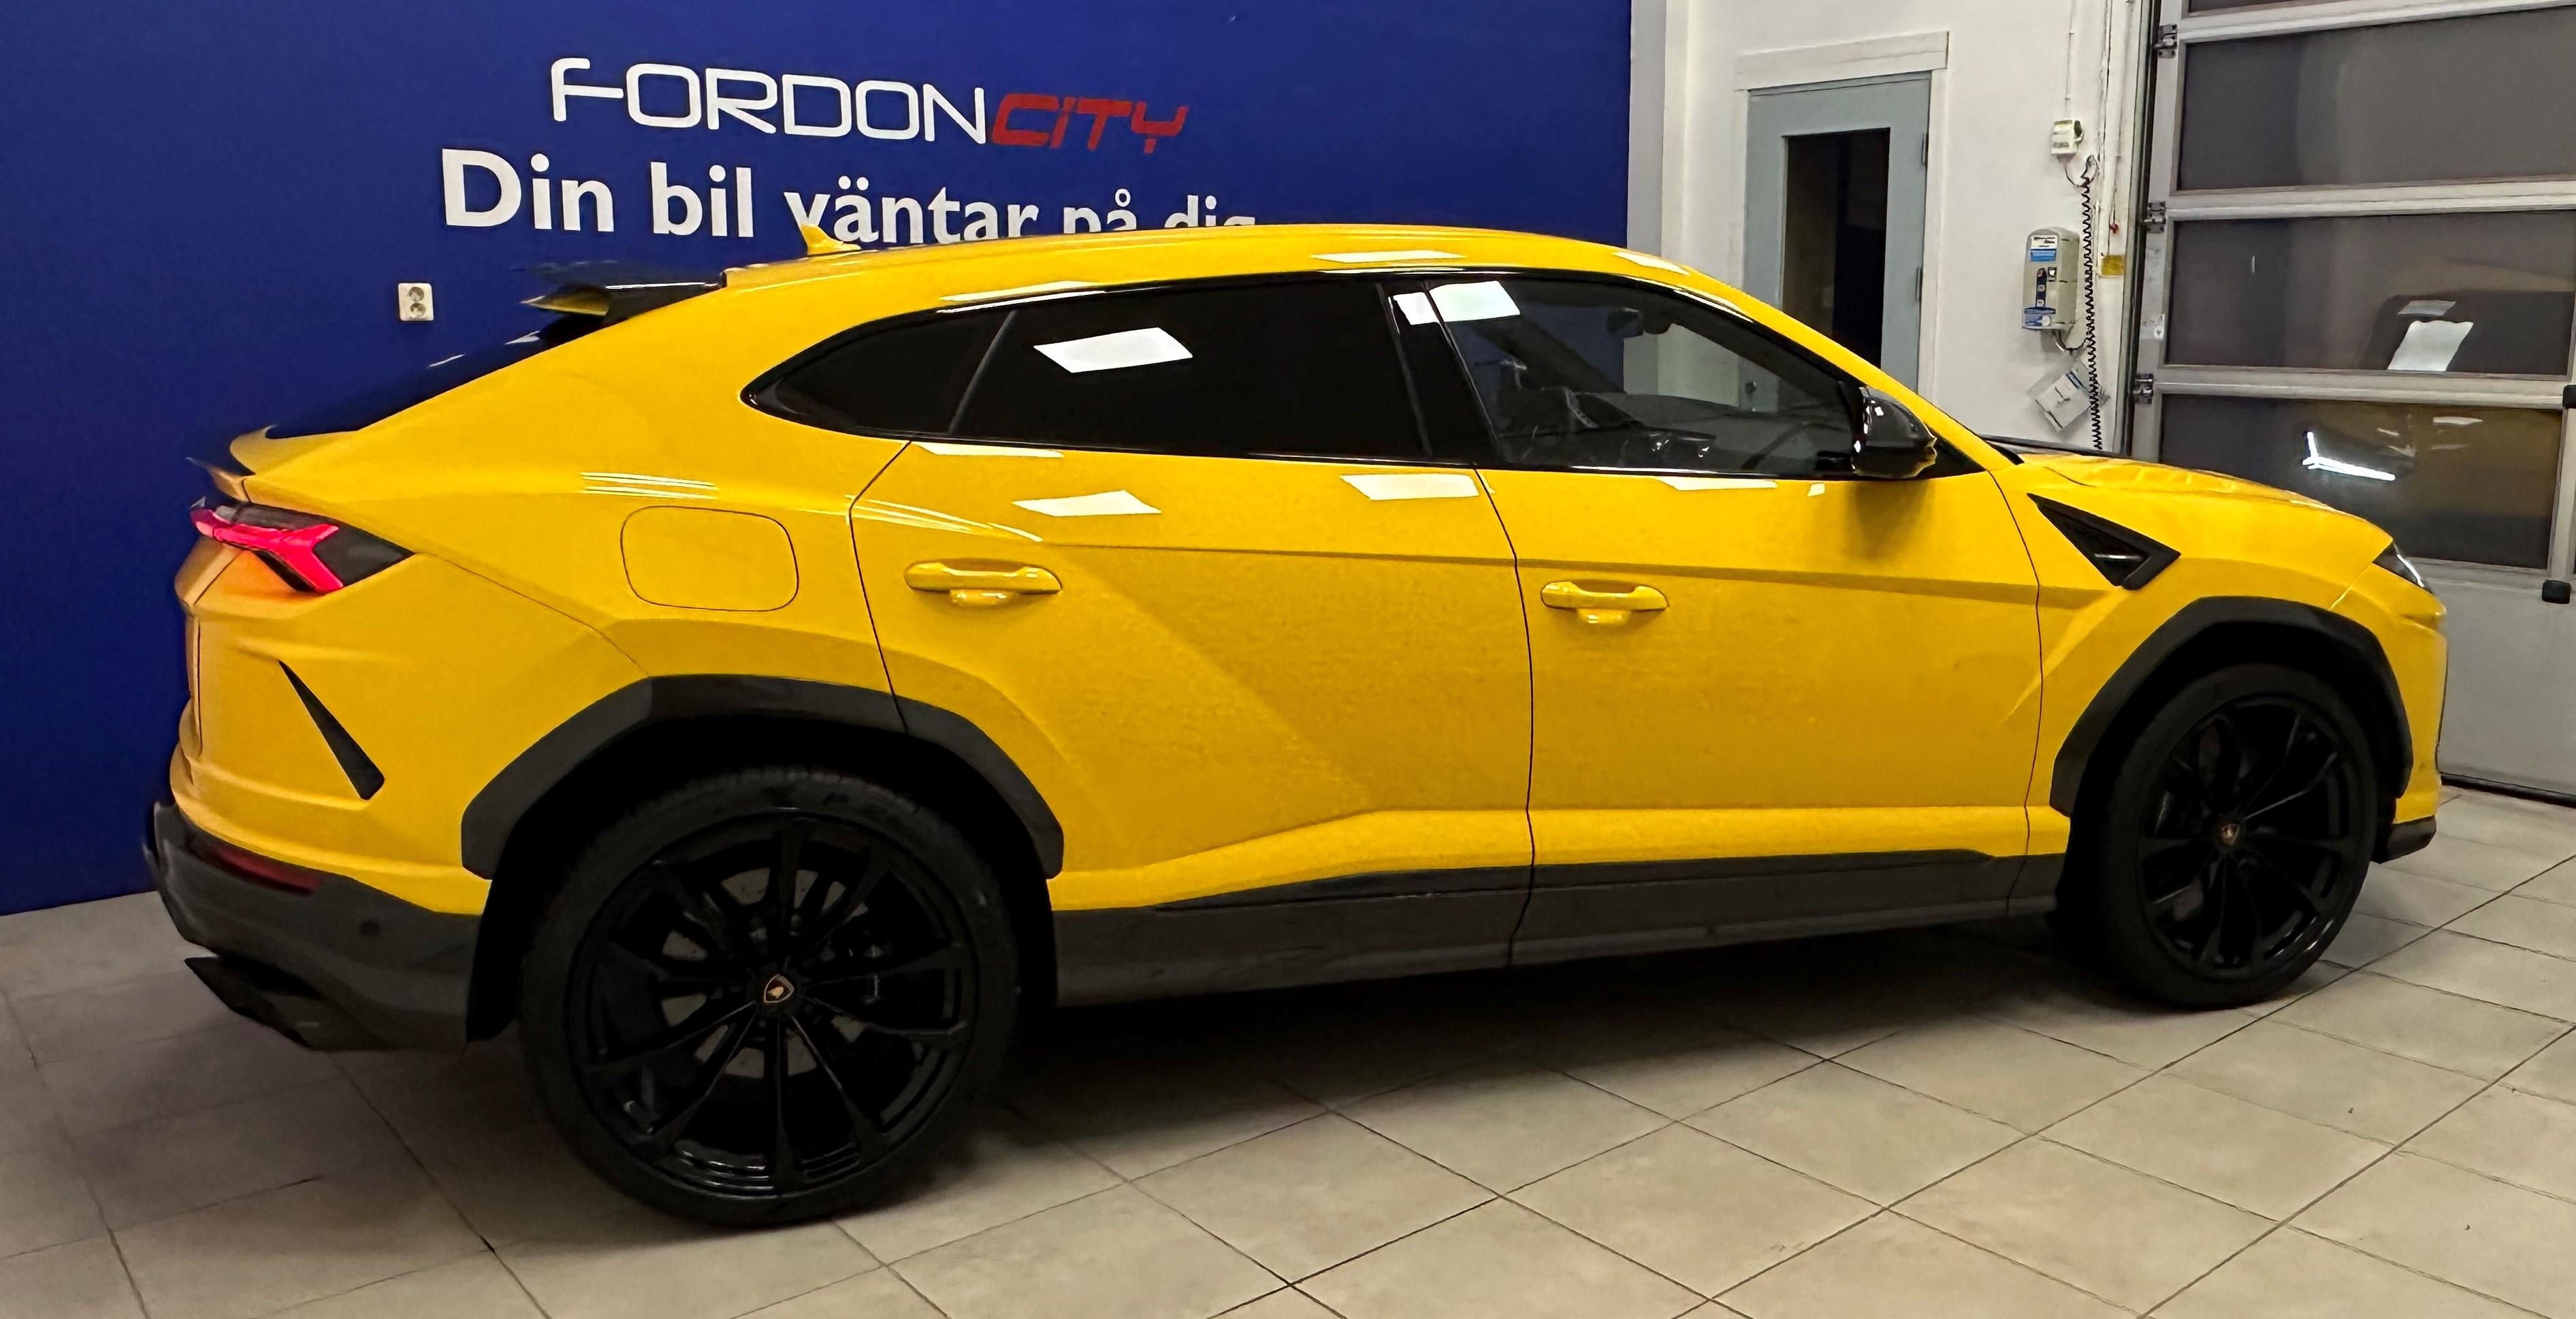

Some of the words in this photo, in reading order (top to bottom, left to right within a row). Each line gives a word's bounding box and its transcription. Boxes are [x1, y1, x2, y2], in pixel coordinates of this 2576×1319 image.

[442, 148, 614, 232] Din
[650, 161, 754, 238] bil
[784, 175, 1040, 244] väntar
[1164, 195, 1255, 228] di
